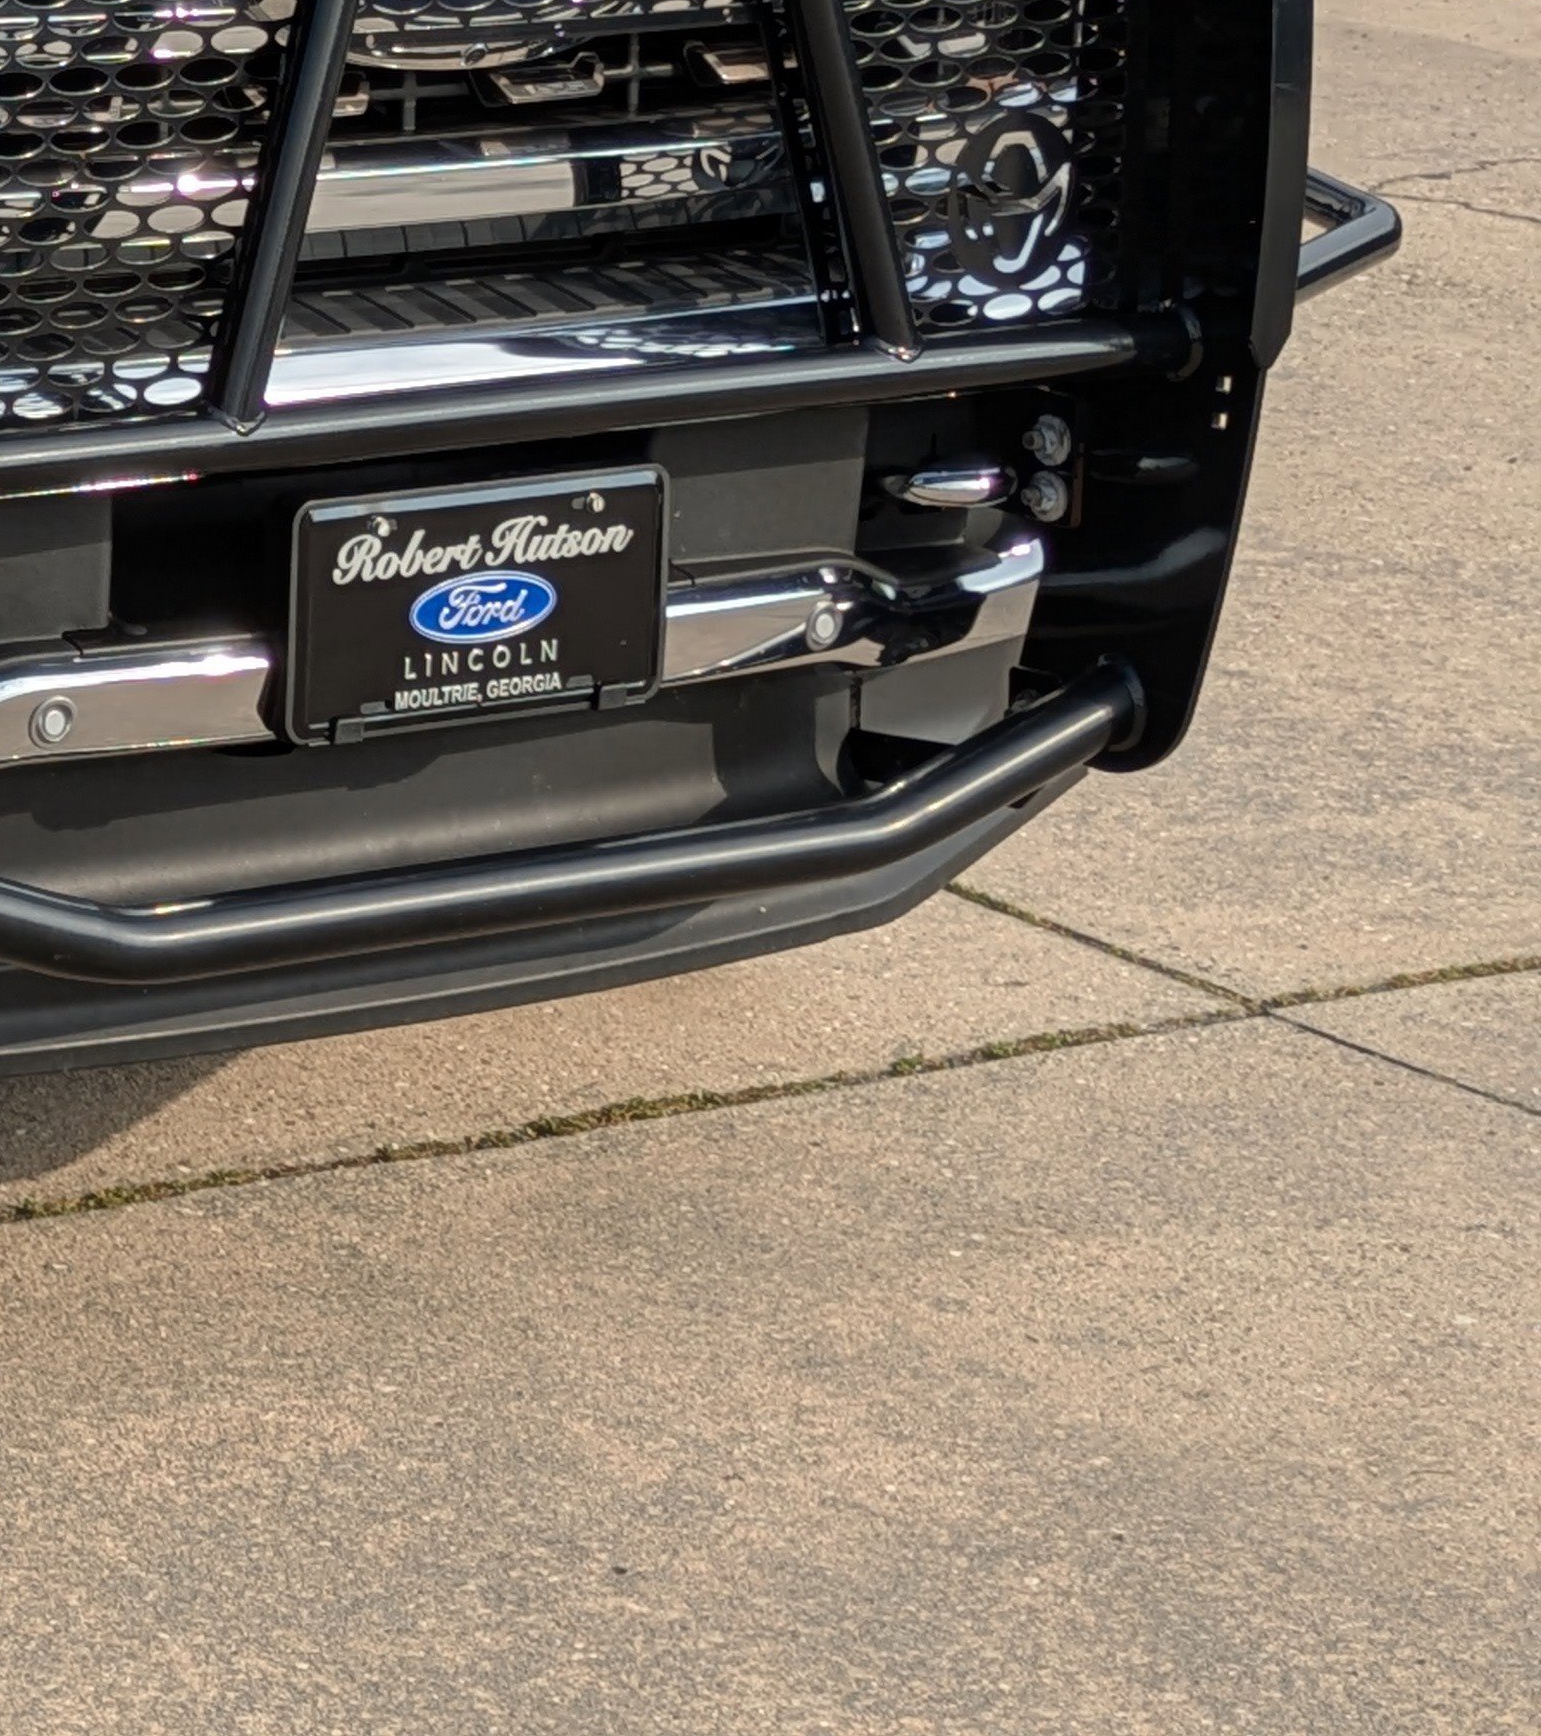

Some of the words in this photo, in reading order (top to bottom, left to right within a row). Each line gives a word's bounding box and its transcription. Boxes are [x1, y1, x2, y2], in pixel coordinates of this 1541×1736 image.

[332, 528, 483, 586] Robert
[484, 515, 635, 567] Hutson
[438, 582, 527, 631] Ford
[403, 639, 560, 681] LINCOLN
[394, 682, 483, 712] MOULTRIE,
[486, 672, 563, 701] GEORGIA
